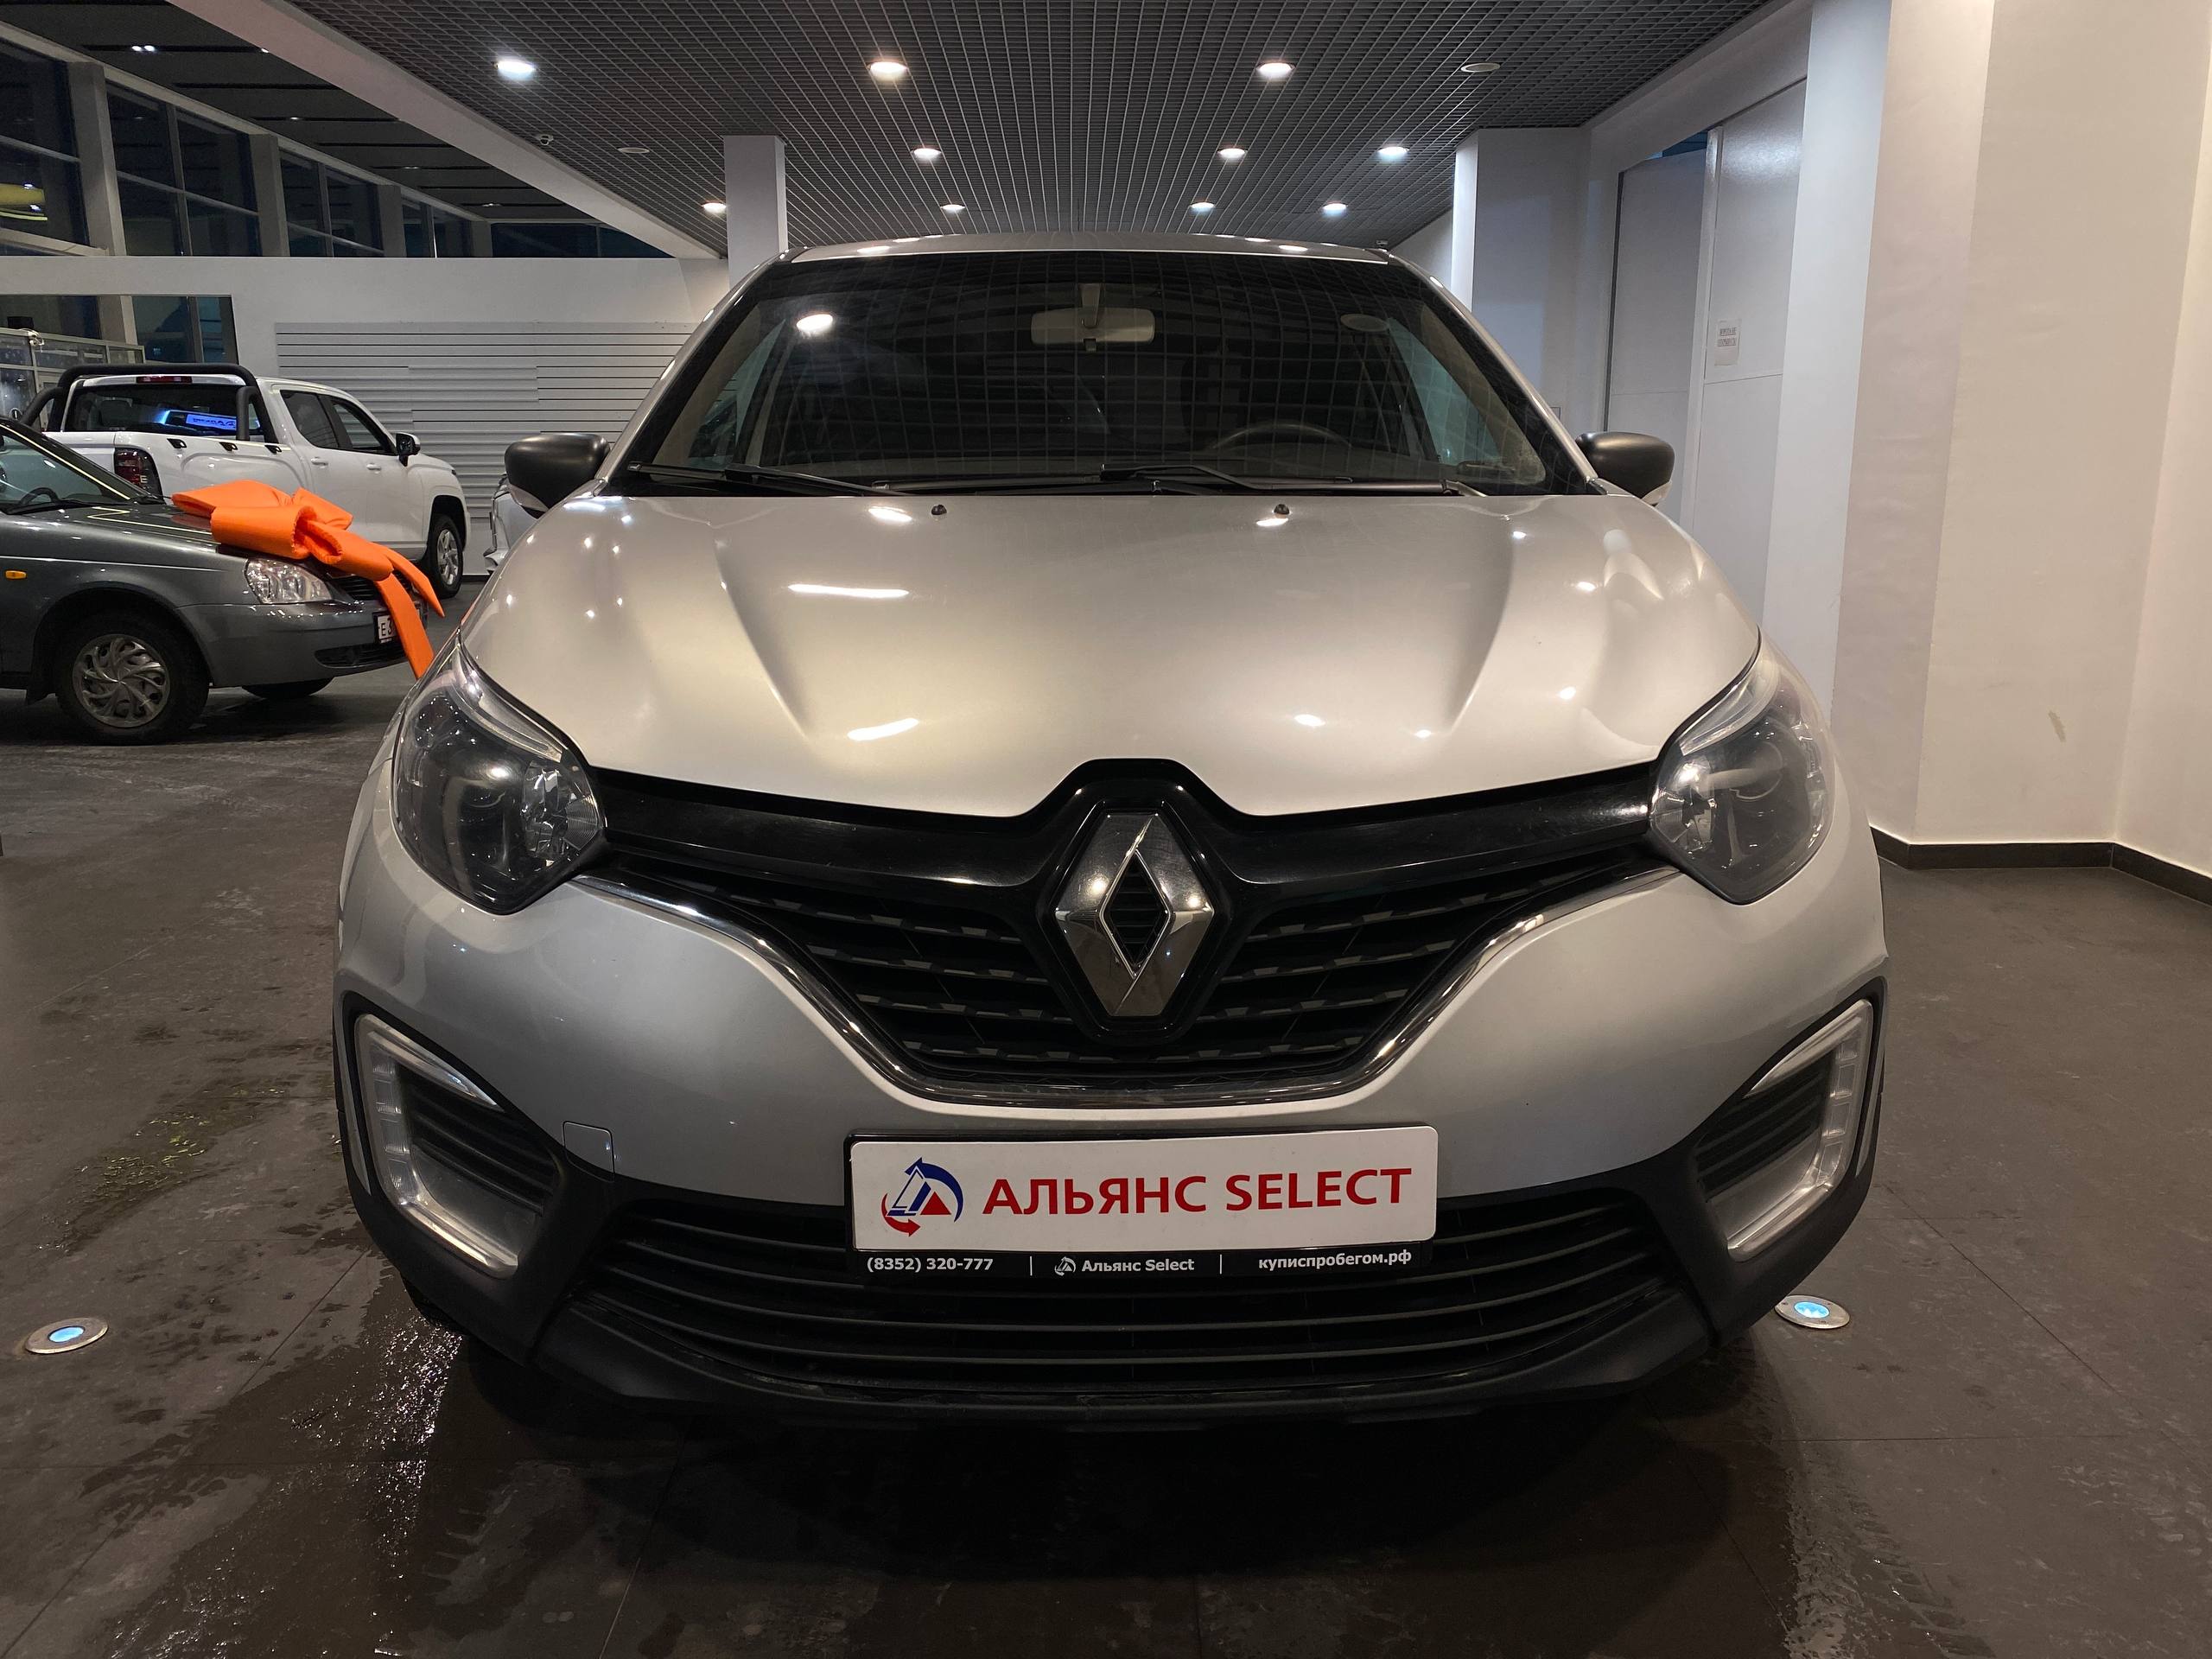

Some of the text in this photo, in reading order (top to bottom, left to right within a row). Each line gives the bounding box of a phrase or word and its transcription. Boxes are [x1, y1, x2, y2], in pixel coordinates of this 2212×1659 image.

[982, 1167, 1412, 1215] АЛЬЯНС SELECT
[867, 1257, 994, 1273] (8352) 320-777
[1081, 1258, 1195, 1272] Альянс Select
[1258, 1249, 1413, 1271] куписпробегом.рф
